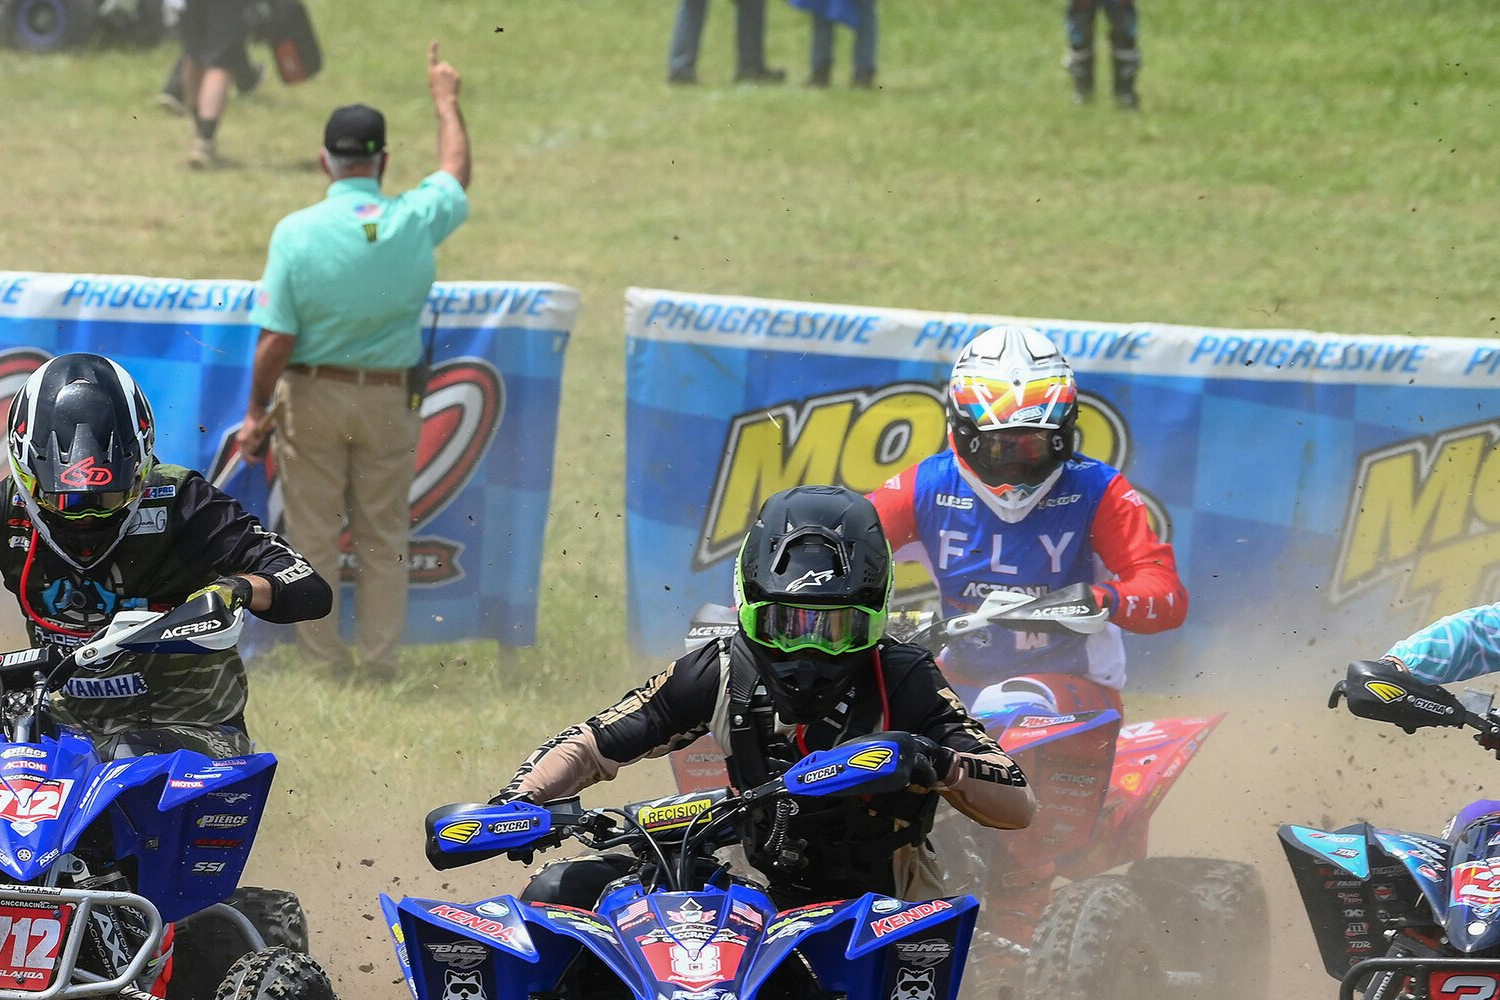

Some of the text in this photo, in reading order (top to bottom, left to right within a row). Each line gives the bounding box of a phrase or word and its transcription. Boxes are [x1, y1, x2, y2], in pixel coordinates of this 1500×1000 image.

[68, 280, 258, 313] PROGRESSI
[428, 288, 552, 316] RESSIVE
[645, 299, 881, 345] PROGRESSIVE
[1190, 335, 1430, 374] PROGRESSIVE
[1031, 605, 1091, 619] ACERBIS
[160, 618, 222, 640] ACERBIS
[64, 676, 142, 699] YAMAHA
[1415, 698, 1446, 714] CYCRA
[3, 760, 46, 771] ACTION!
[804, 765, 837, 784] CYCRA
[169, 780, 204, 788] MOTUL
[199, 814, 249, 828] PIERCE
[494, 819, 530, 833] CYCRA
[192, 861, 226, 873] SSI
[428, 903, 518, 943] KENDA
[869, 899, 953, 938] KENDA
[428, 943, 488, 954] BNR
[896, 942, 951, 952] BNR
[1348, 940, 1372, 949] TDR
[668, 941, 722, 979] 8
